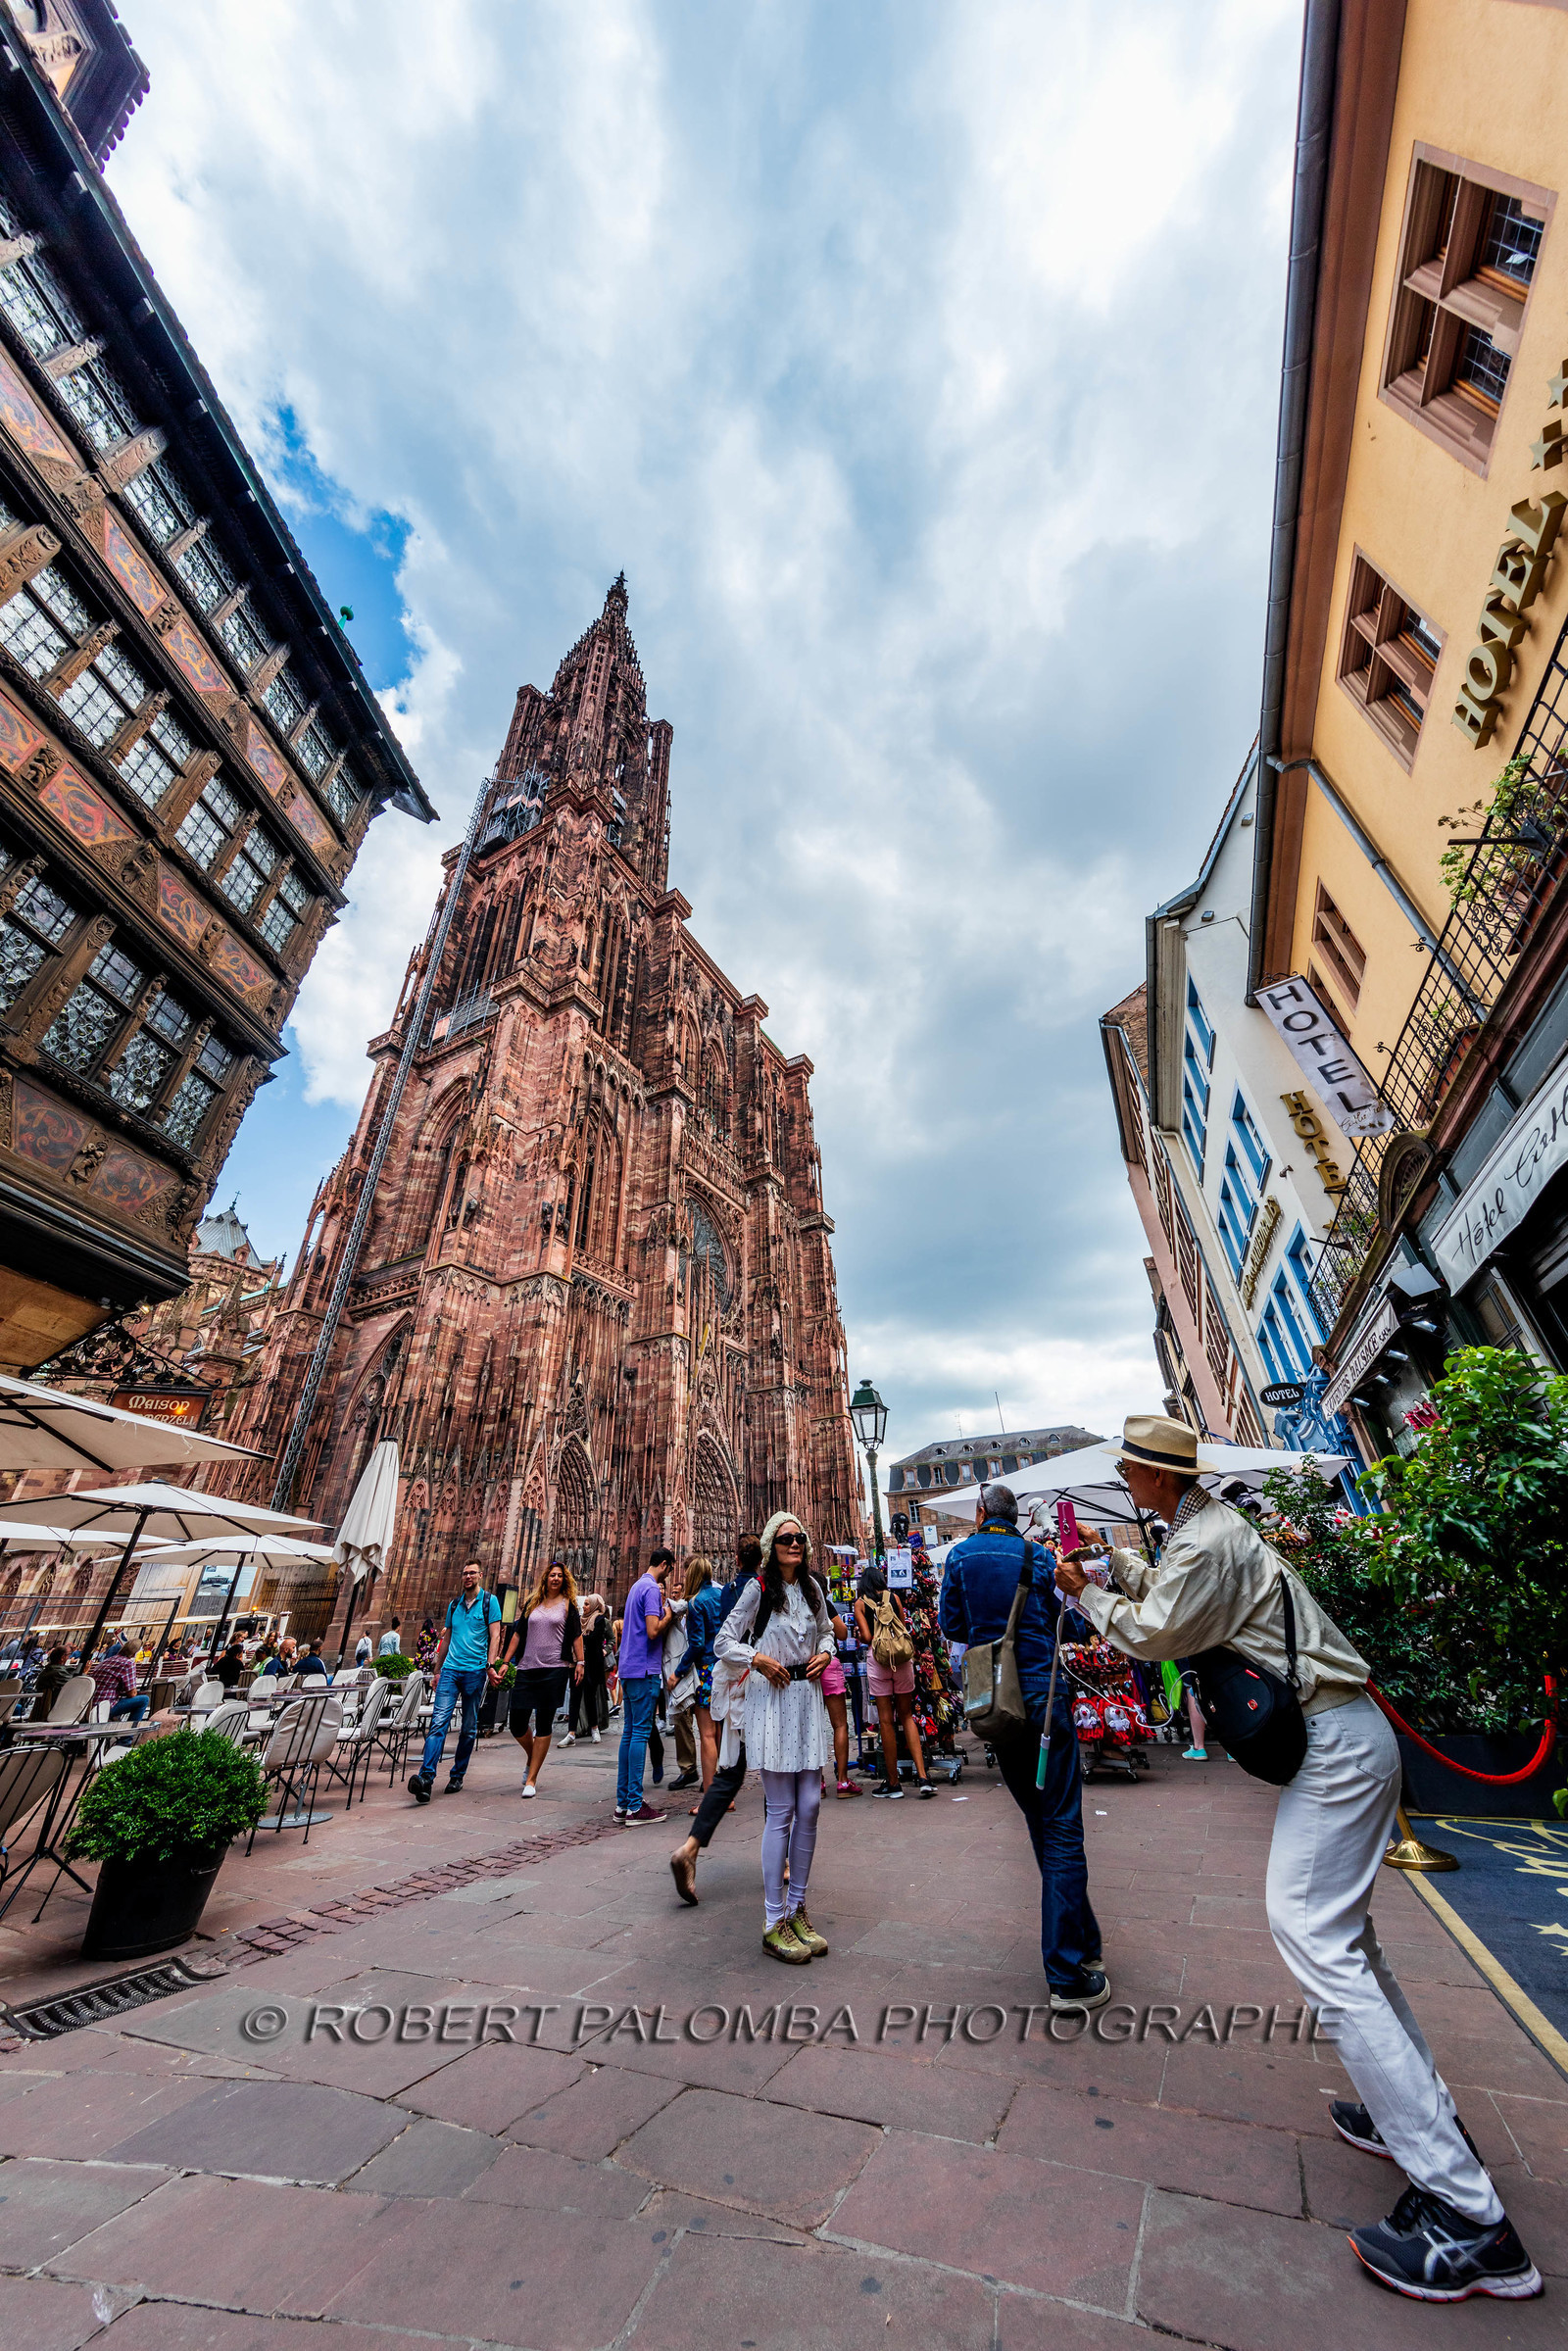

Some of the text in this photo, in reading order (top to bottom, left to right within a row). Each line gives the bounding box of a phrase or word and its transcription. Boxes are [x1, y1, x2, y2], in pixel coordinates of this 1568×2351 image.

[1451, 490, 1568, 751] HOTEL
[1266, 985, 1372, 1113] HOTEL
[1264, 1388, 1300, 1401] HOTEL
